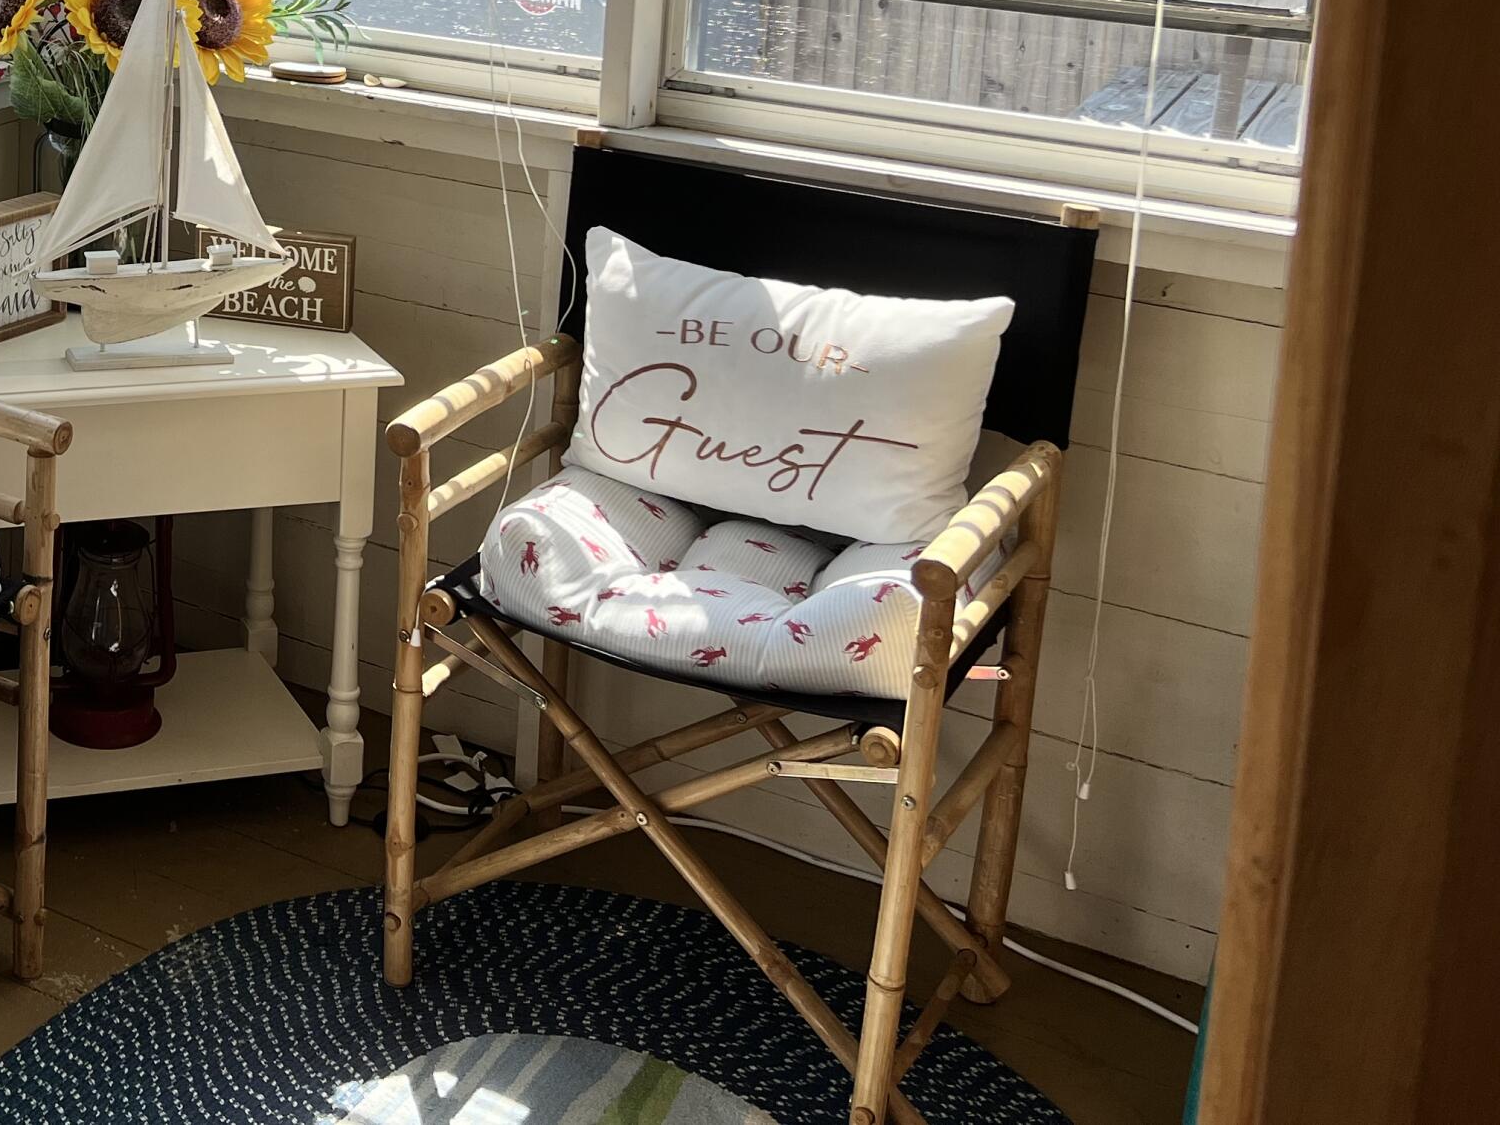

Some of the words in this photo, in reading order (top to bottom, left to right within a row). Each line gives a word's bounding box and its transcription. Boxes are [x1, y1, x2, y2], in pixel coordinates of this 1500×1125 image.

[267, 275, 296, 292] the
[221, 290, 324, 324] BEACH
[591, 361, 919, 501] Guest
